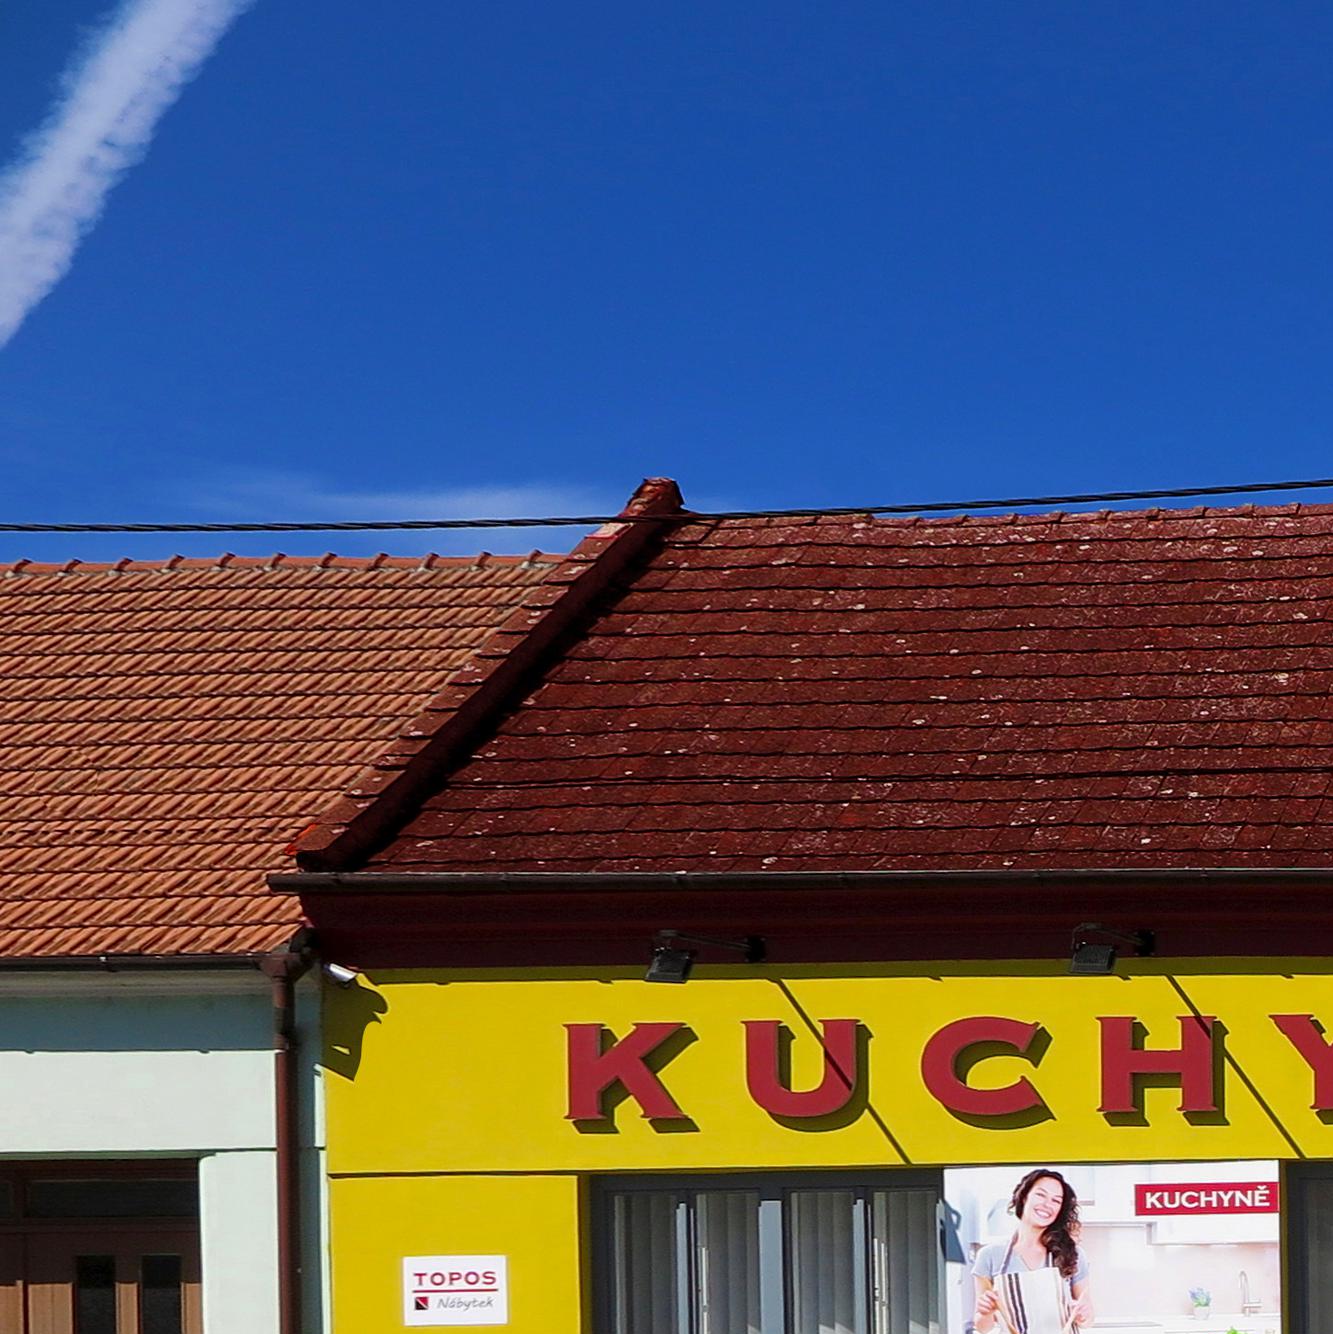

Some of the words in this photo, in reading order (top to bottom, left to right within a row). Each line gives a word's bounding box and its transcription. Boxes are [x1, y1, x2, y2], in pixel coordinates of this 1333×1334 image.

[1145, 1185, 1270, 1209] KUCHYNĚ
[413, 1271, 497, 1286] TOPOS
[436, 1296, 495, 1312] Nábytek
